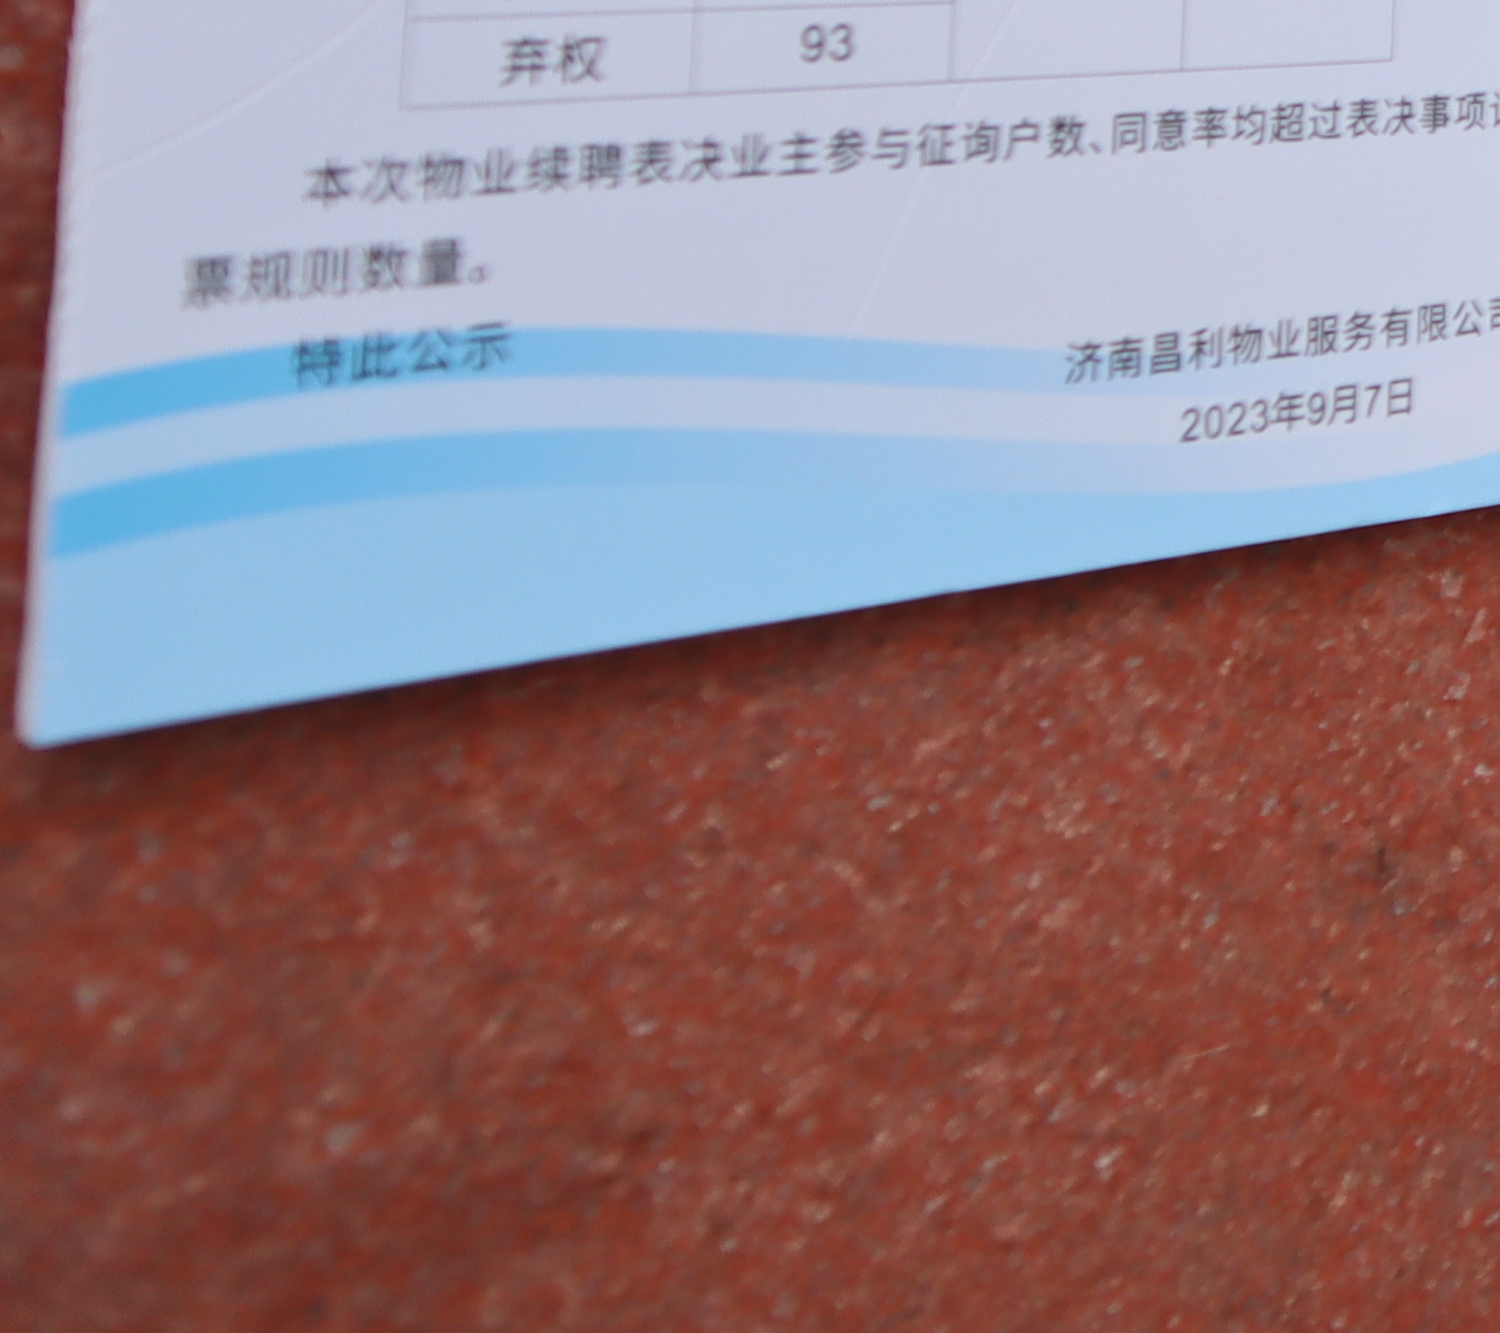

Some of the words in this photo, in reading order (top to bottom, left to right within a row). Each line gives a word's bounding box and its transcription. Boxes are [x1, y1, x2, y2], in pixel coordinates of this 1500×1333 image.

[498, 35, 607, 87] 弃权
[799, 23, 856, 63] 93
[180, 237, 493, 311] 票规则数量。
[290, 320, 512, 388] 特此公示
[1180, 378, 1415, 443] 2023年9月7日
